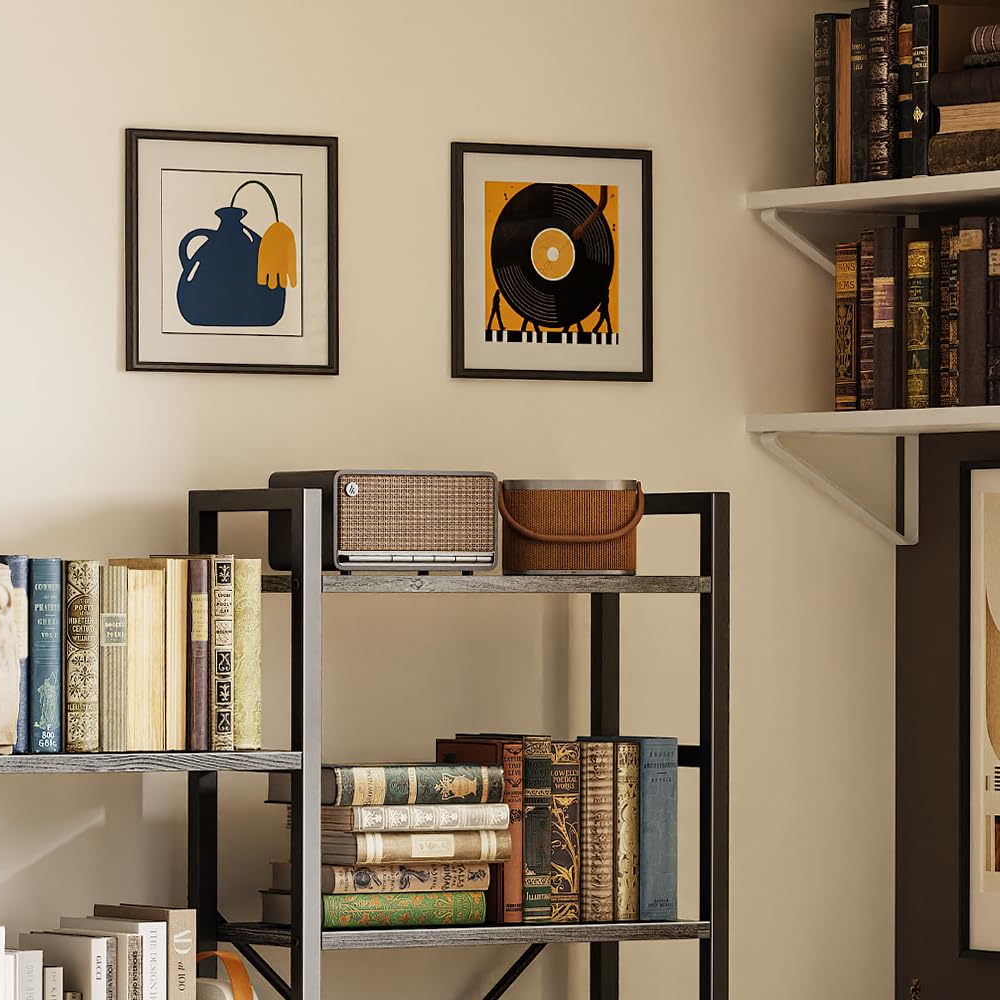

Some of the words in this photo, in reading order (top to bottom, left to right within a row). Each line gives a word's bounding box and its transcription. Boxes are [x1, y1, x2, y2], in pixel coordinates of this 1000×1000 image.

[150, 929, 158, 950] THE
[150, 952, 158, 990] DESIGN
[178, 973, 186, 992] 100
